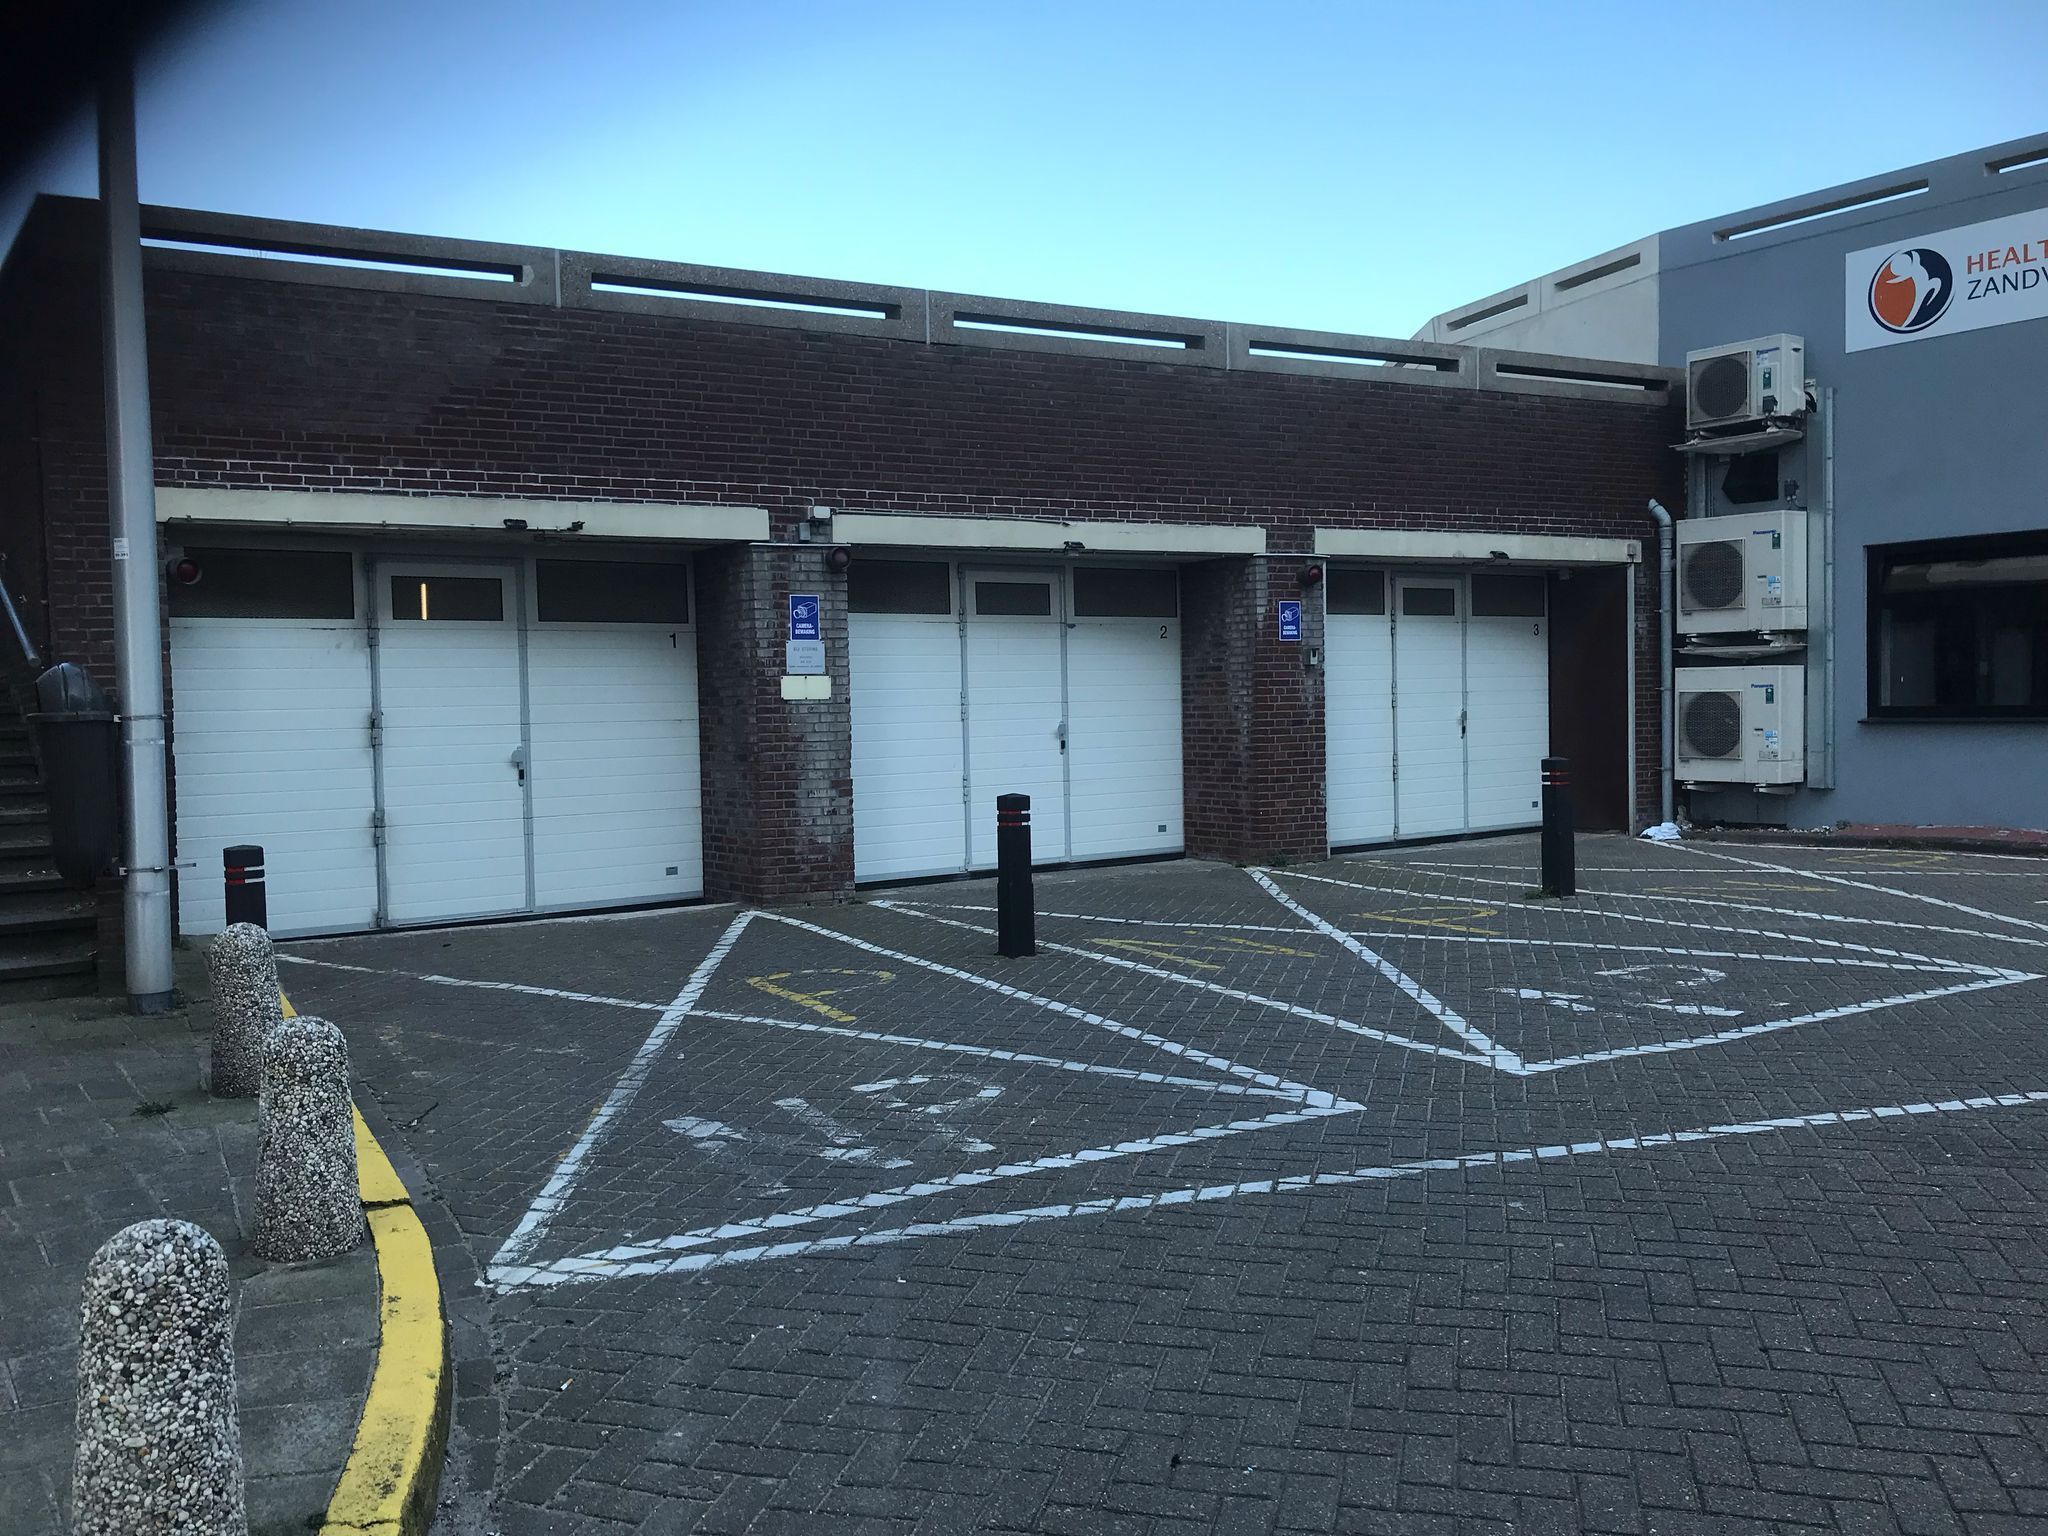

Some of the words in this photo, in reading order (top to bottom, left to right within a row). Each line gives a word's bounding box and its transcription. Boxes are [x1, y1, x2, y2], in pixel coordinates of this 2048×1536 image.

[1967, 240, 2048, 275] HEALT
[1160, 625, 1168, 639] 2
[1533, 624, 1540, 636] 3
[669, 632, 677, 649] 1
